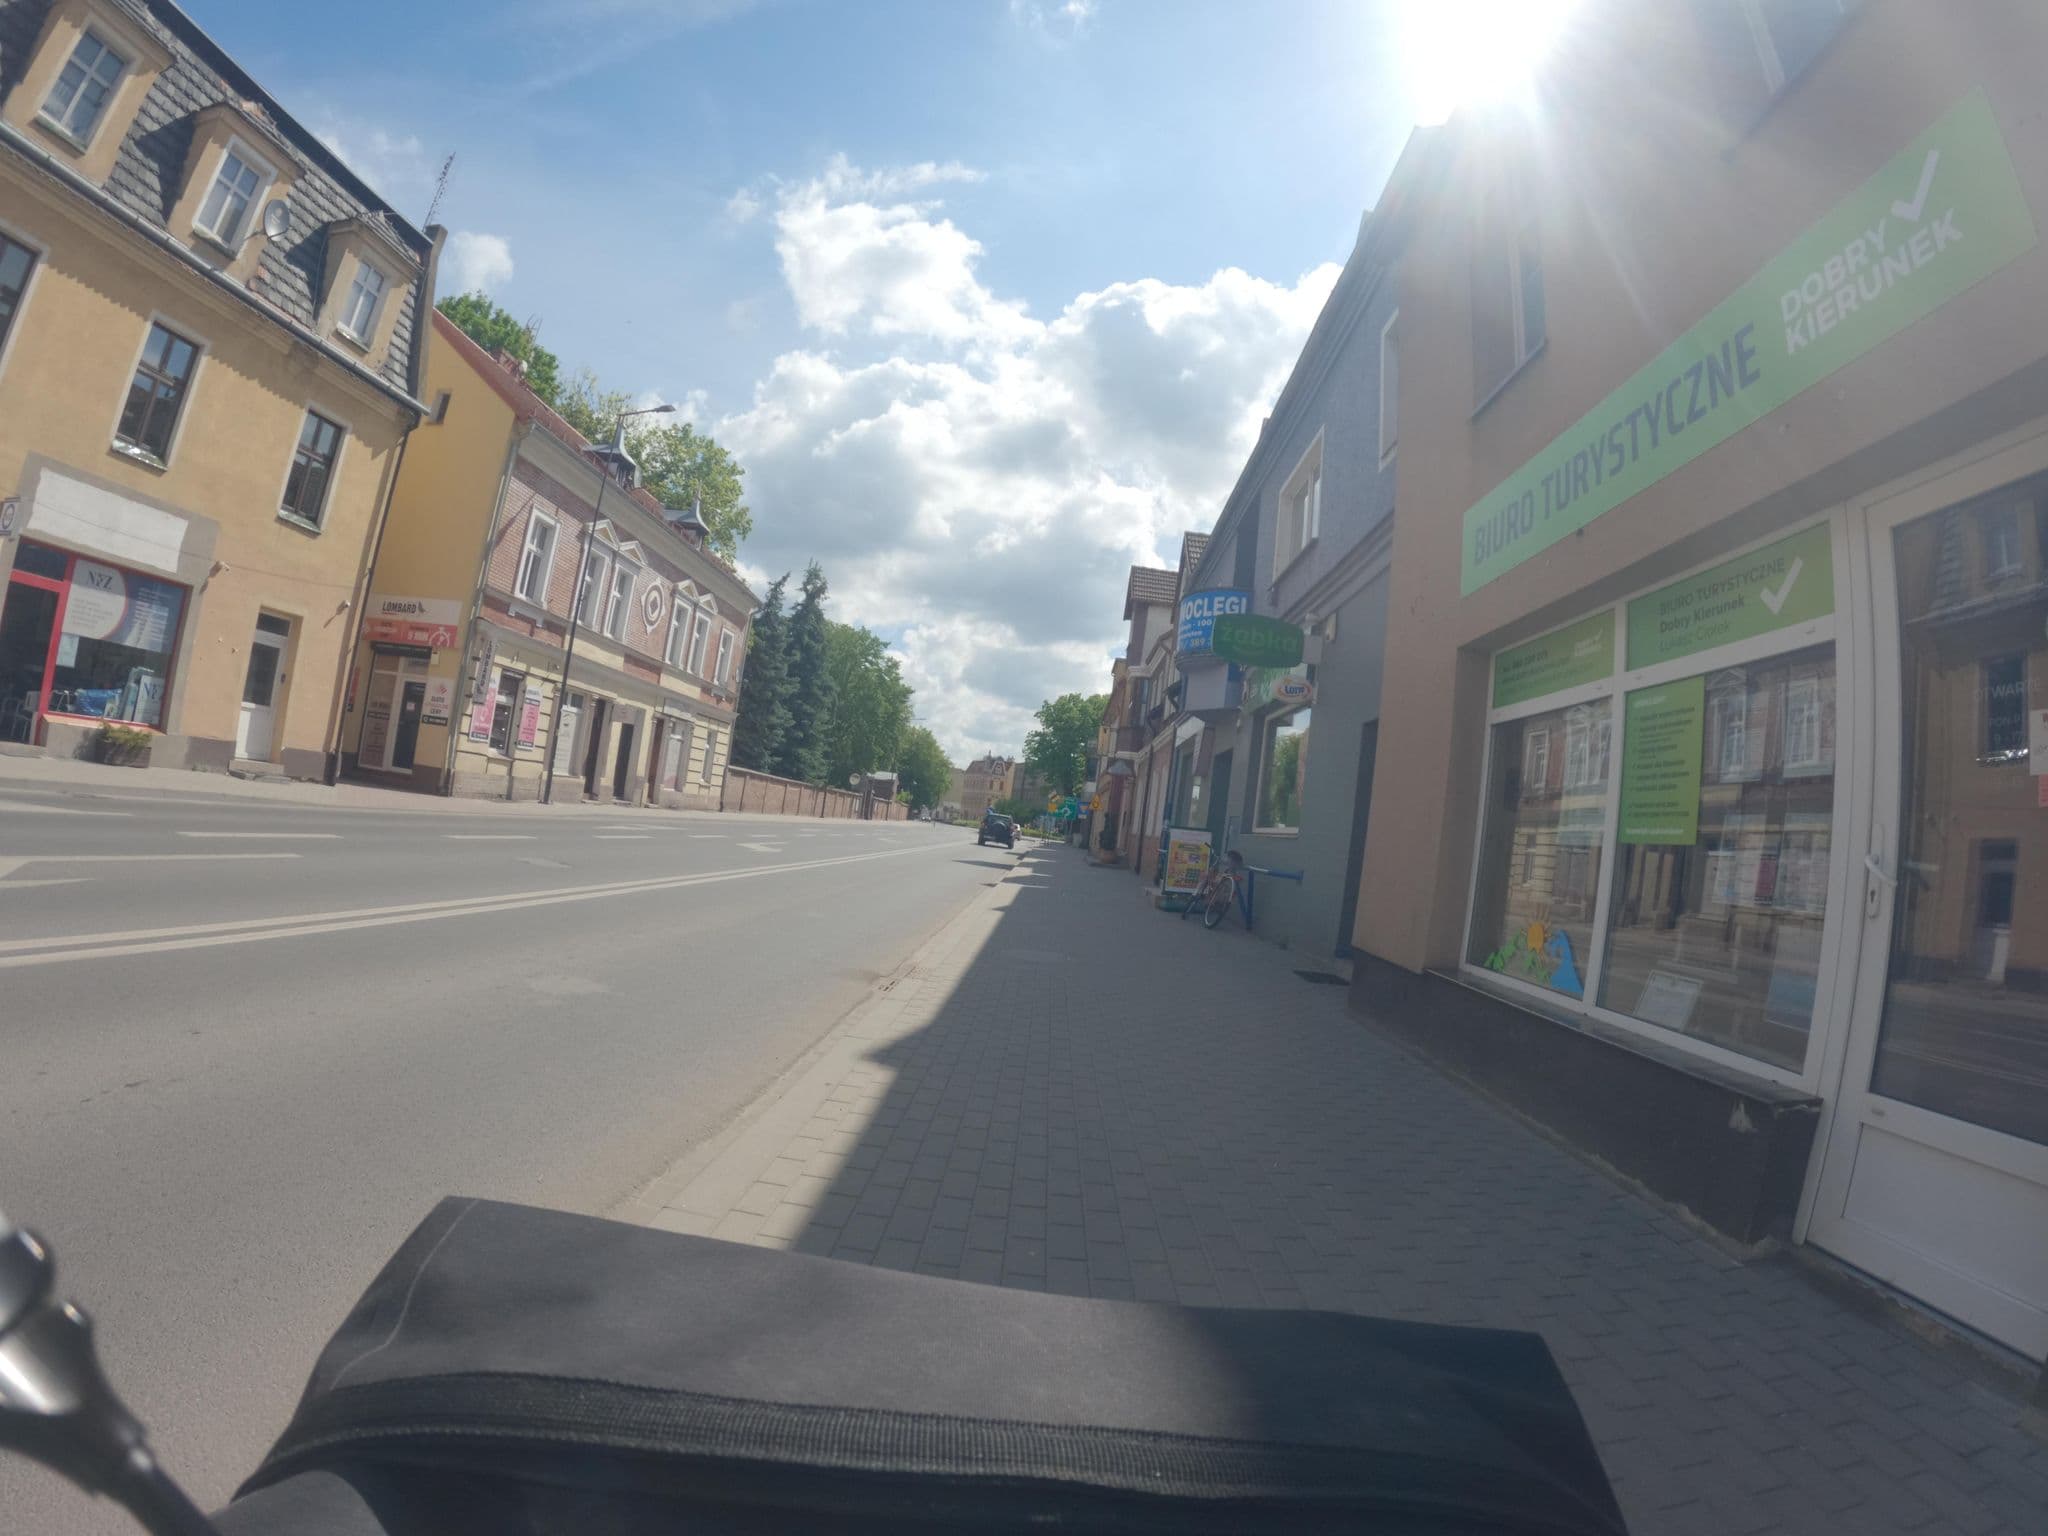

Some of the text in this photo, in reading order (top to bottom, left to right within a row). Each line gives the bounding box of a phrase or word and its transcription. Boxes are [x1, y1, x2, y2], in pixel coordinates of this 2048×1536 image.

[1781, 218, 1887, 322] DOBRY
[1784, 207, 1963, 356] KIERUNEK
[1474, 321, 1761, 566] BIURO TURYSTYCZNE
[382, 600, 417, 614] LOMBARD
[1660, 557, 1785, 616] BIURO TURYSTYCZNE
[1660, 593, 1745, 634] Dobry Kierunek
